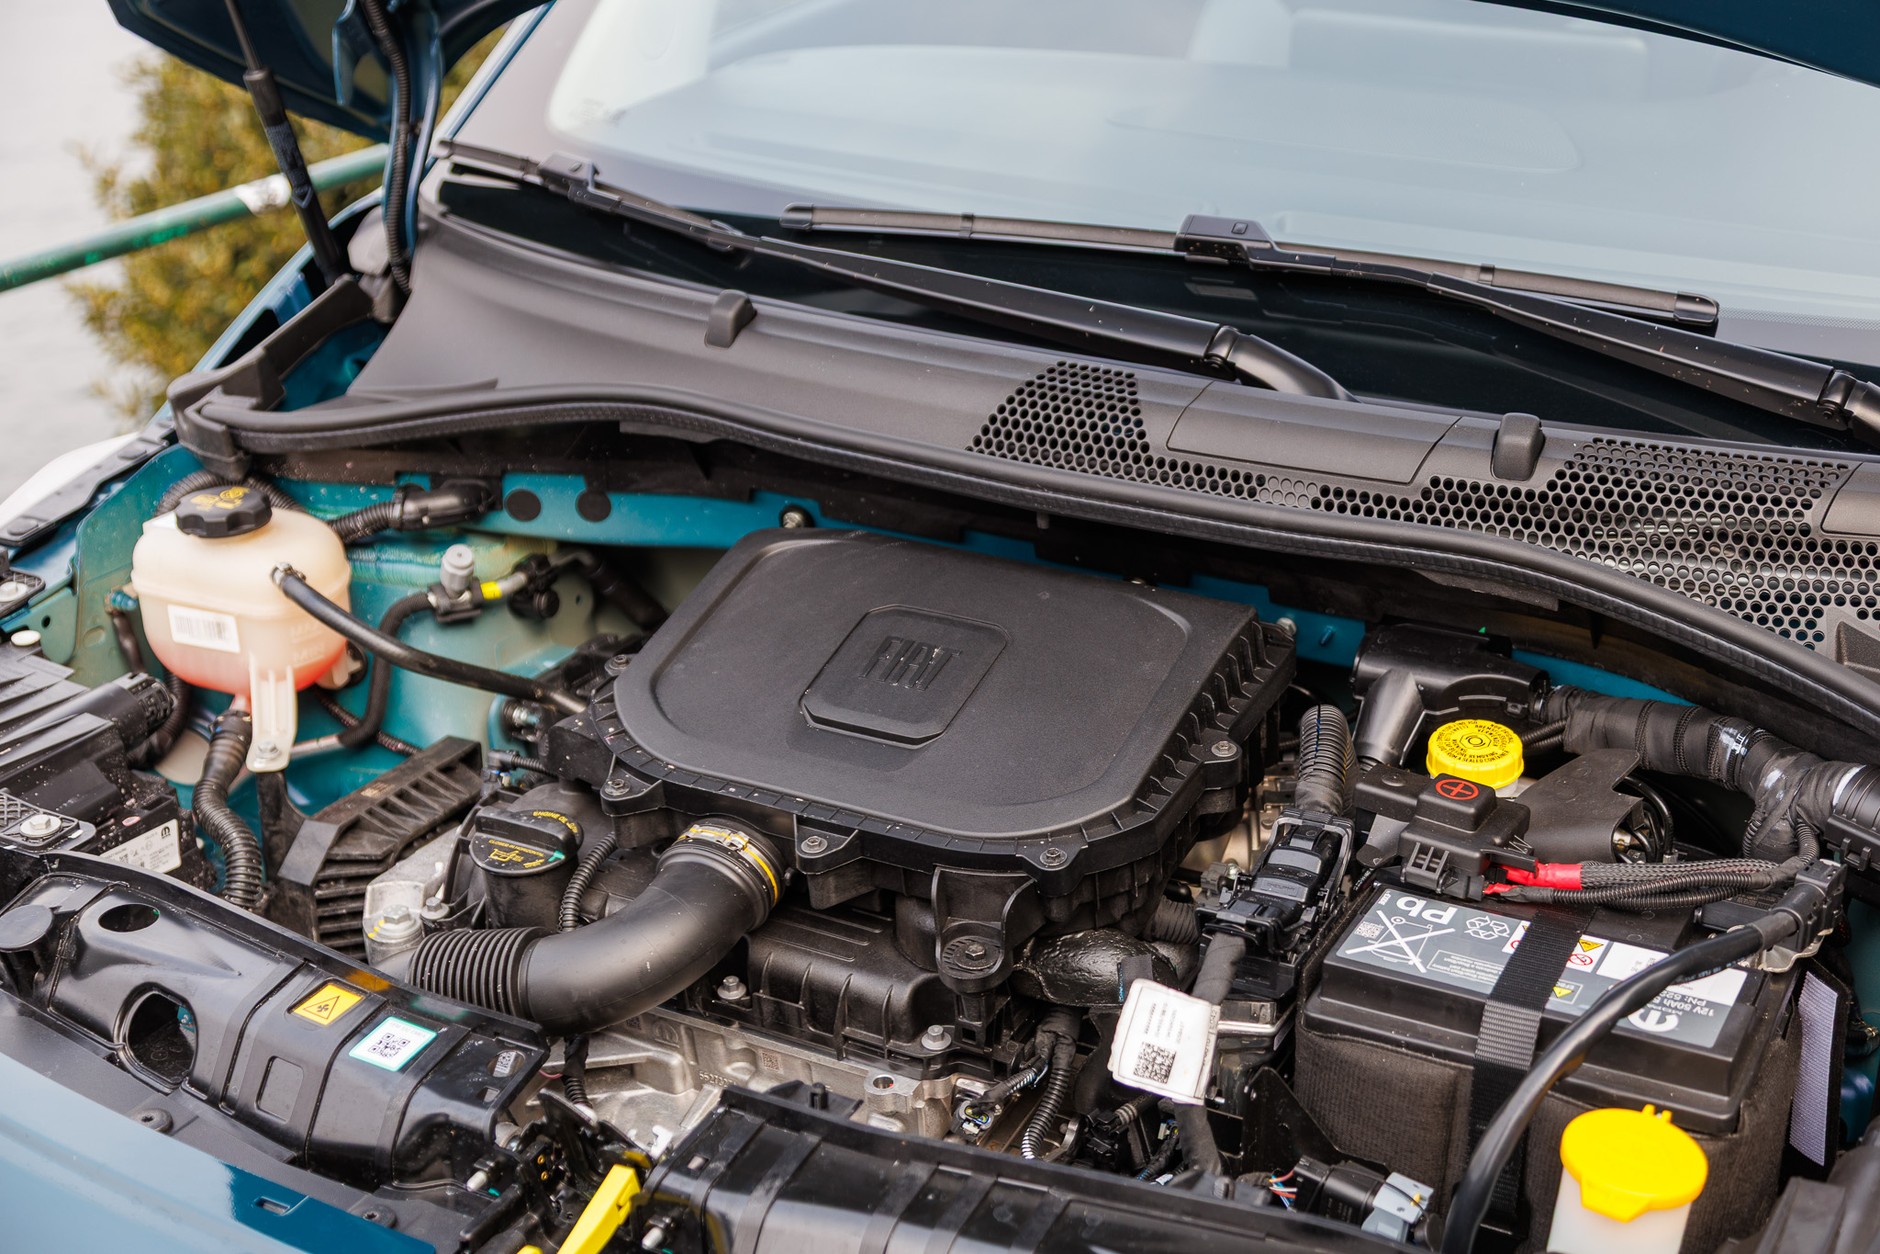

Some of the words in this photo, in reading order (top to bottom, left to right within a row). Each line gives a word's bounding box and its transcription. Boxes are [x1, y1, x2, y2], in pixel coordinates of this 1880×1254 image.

[858, 636, 963, 691] FIAT
[533, 811, 561, 820] ENGINE
[1396, 896, 1459, 927] Pb
[1663, 998, 1692, 1013] 50Ah
[1684, 996, 1707, 1007] PN:
[1646, 1004, 1683, 1017] MOPA
[1692, 1006, 1715, 1017] 12V
